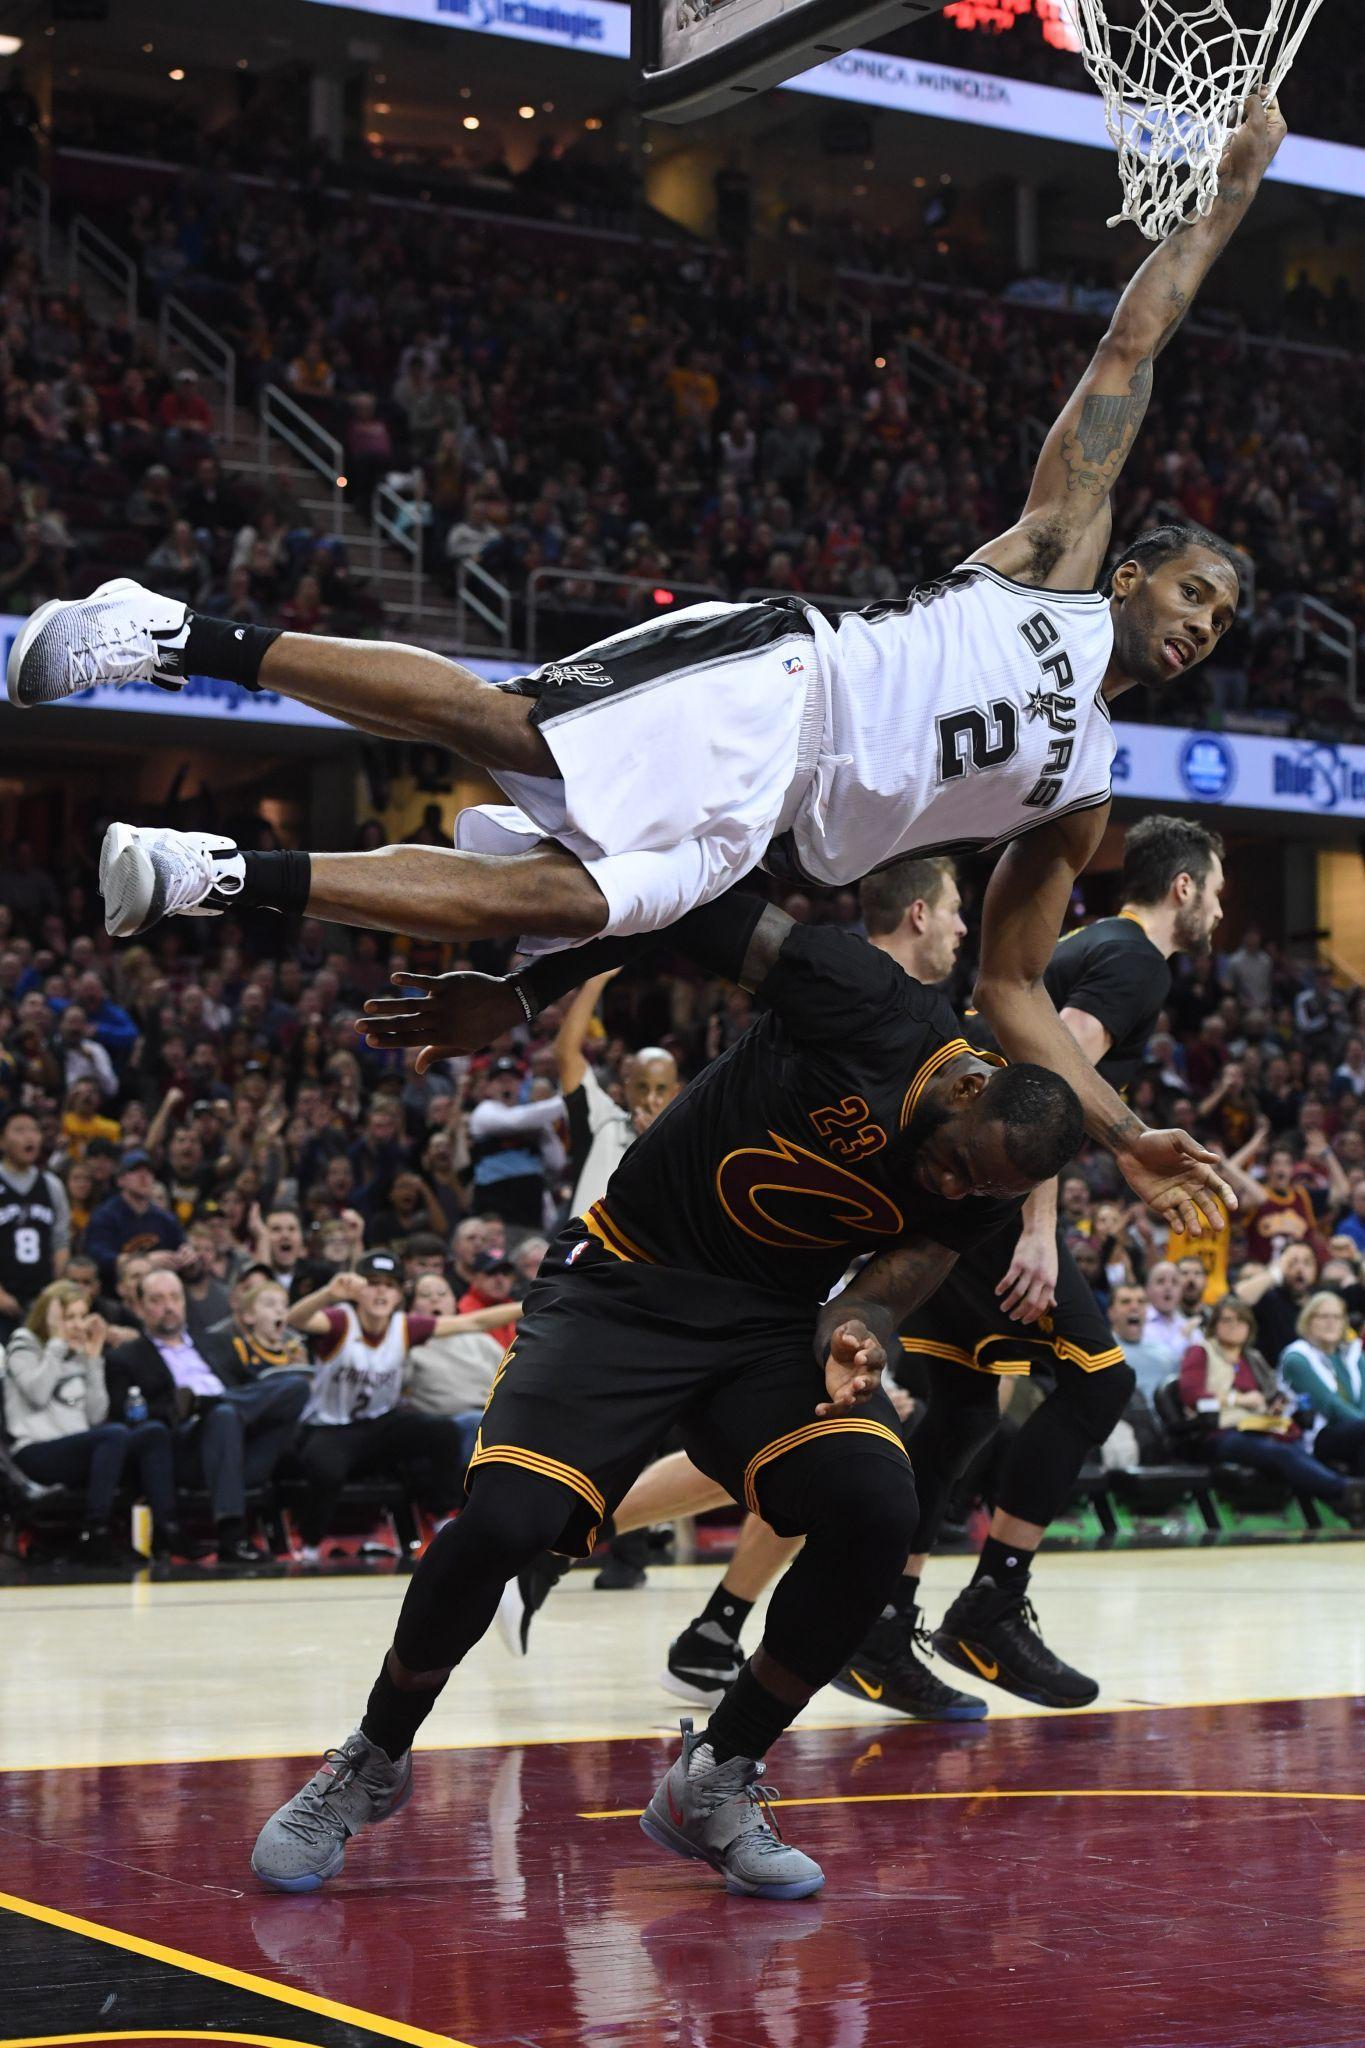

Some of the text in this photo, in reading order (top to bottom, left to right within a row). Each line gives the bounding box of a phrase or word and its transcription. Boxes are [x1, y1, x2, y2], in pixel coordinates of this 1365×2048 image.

[914, 71, 1013, 104] MINOLTA
[934, 697, 1020, 787] 2
[1017, 609, 1077, 808] SPURS
[809, 1096, 887, 1163] 23
[14, 1227, 41, 1264] 8
